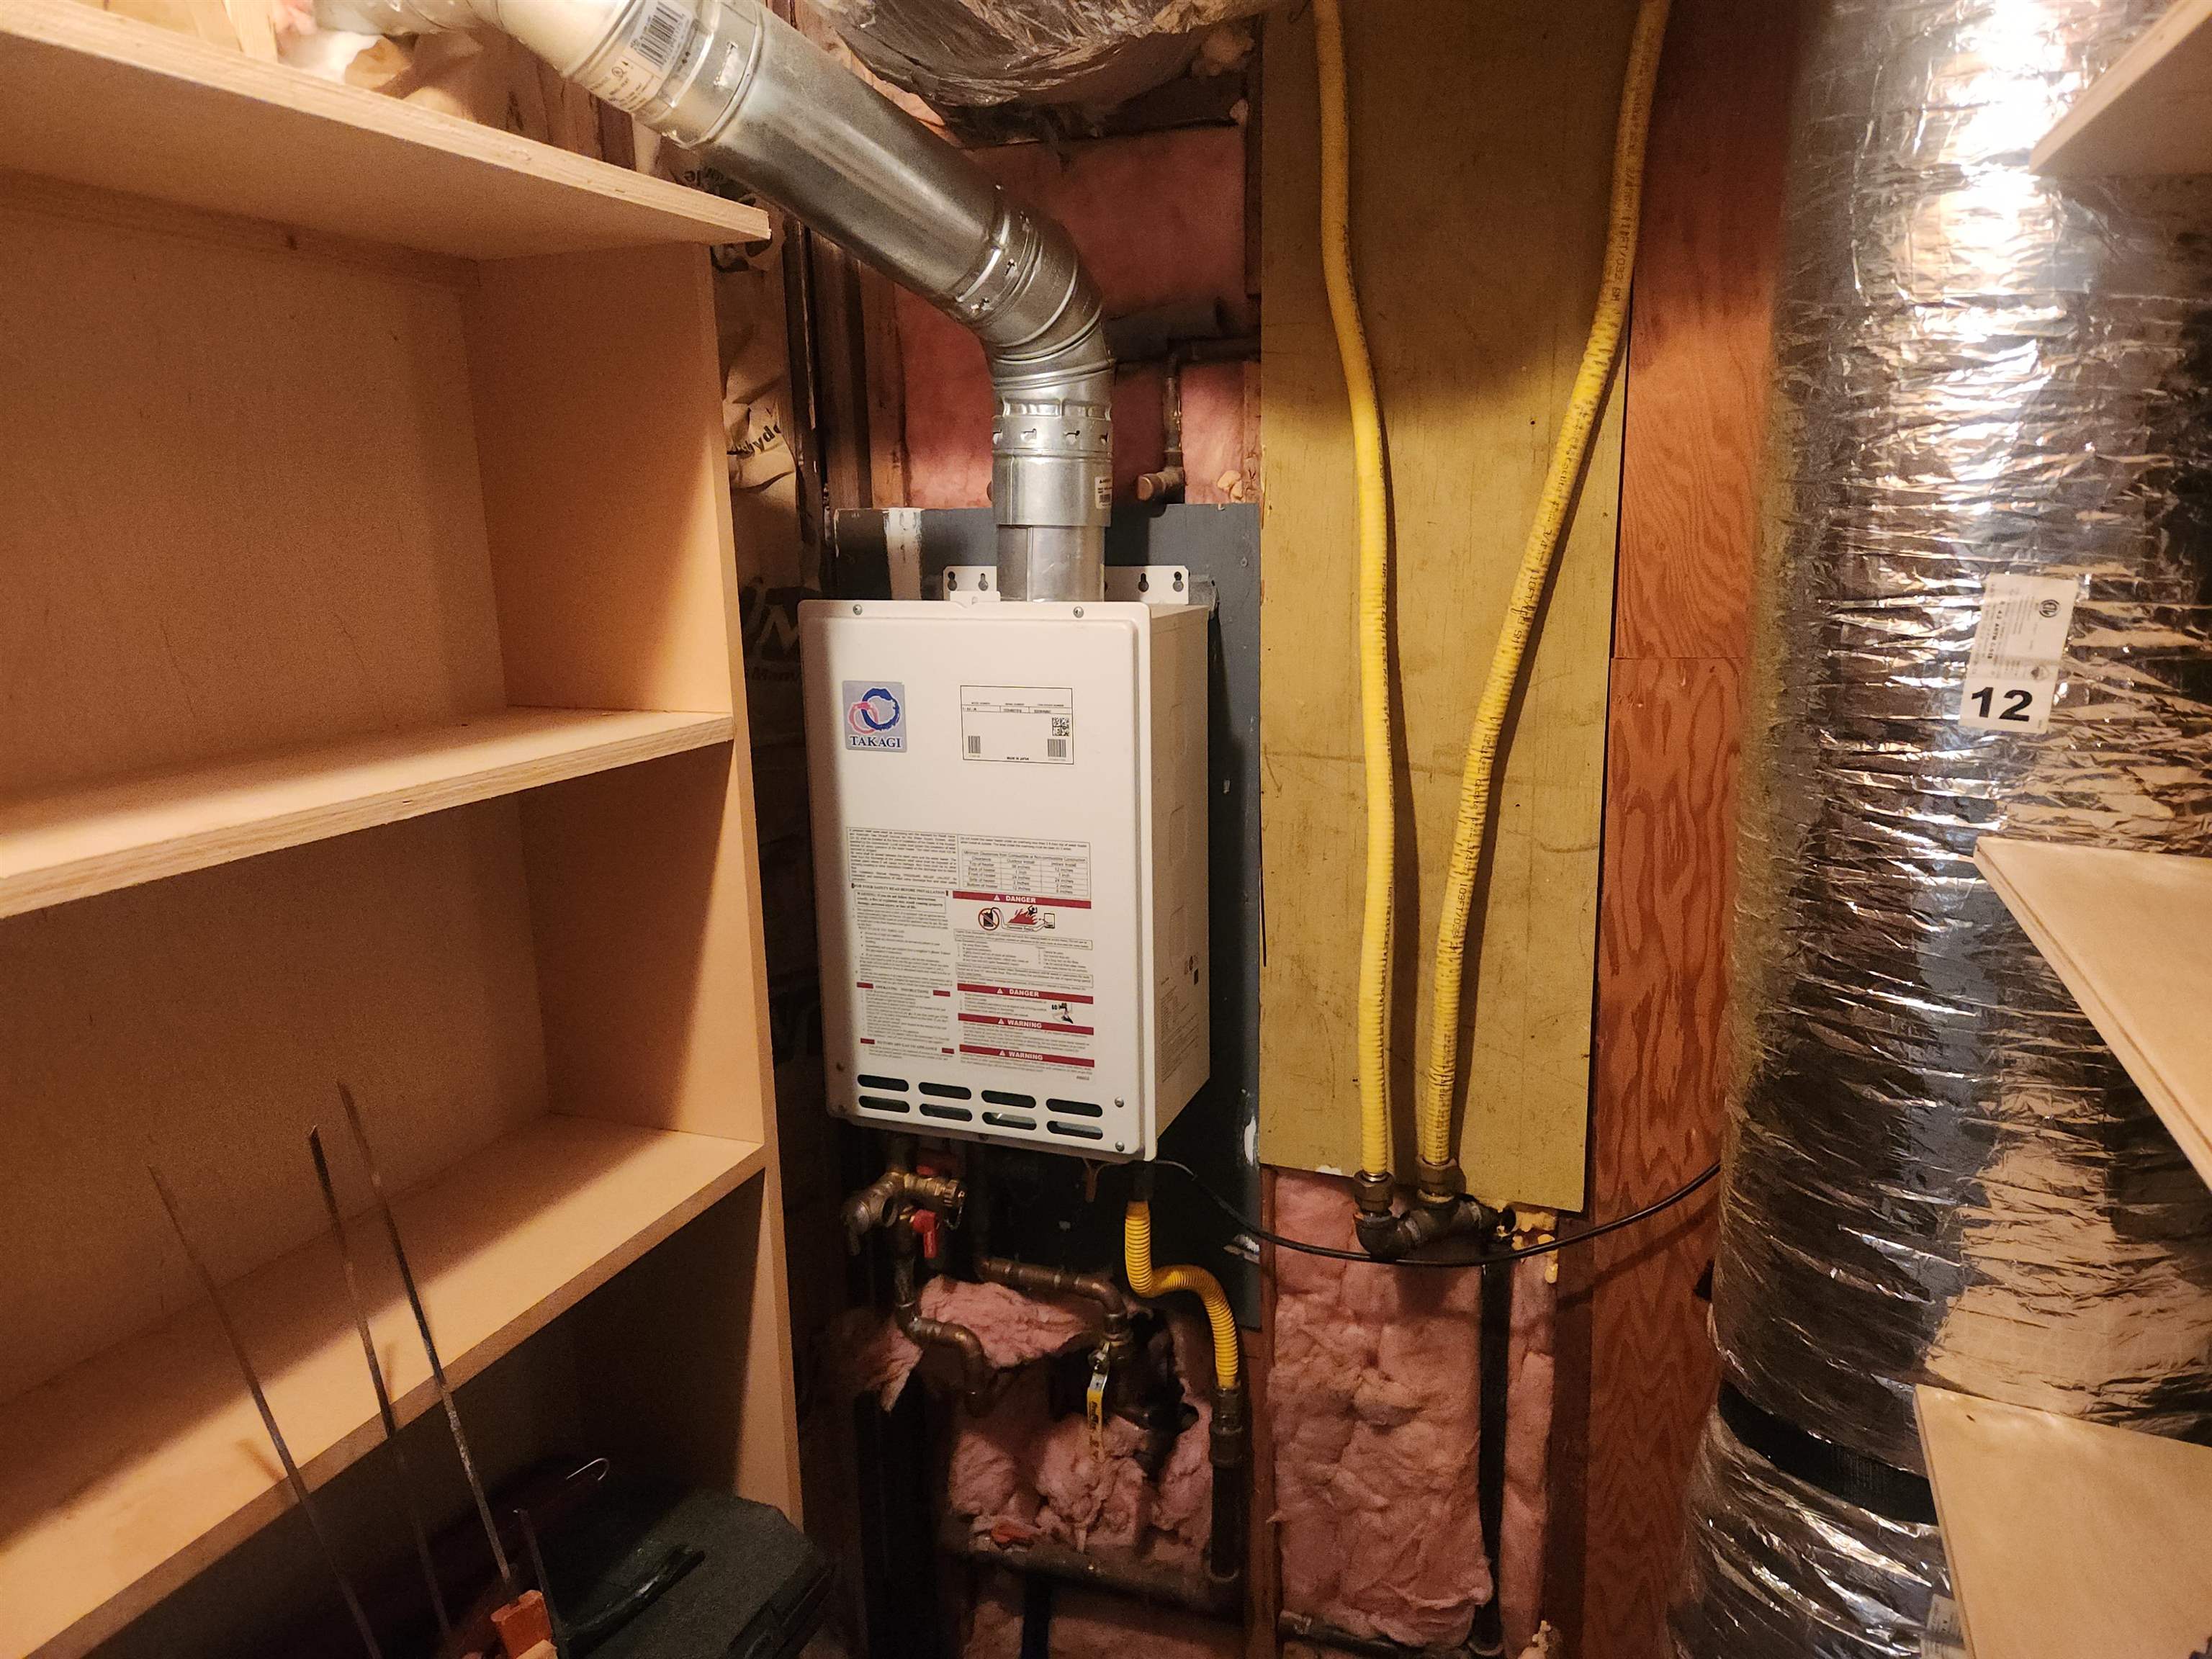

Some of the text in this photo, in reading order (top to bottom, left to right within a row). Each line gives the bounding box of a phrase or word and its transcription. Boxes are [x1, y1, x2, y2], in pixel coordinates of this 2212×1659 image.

[1971, 686, 2033, 722] 12
[850, 736, 902, 747] TAKAGI
[1006, 895, 1036, 904] DANGER
[1010, 989, 1039, 997] DANGER
[1007, 1019, 1042, 1028] WARNING
[1009, 1051, 1043, 1061] WARNING
